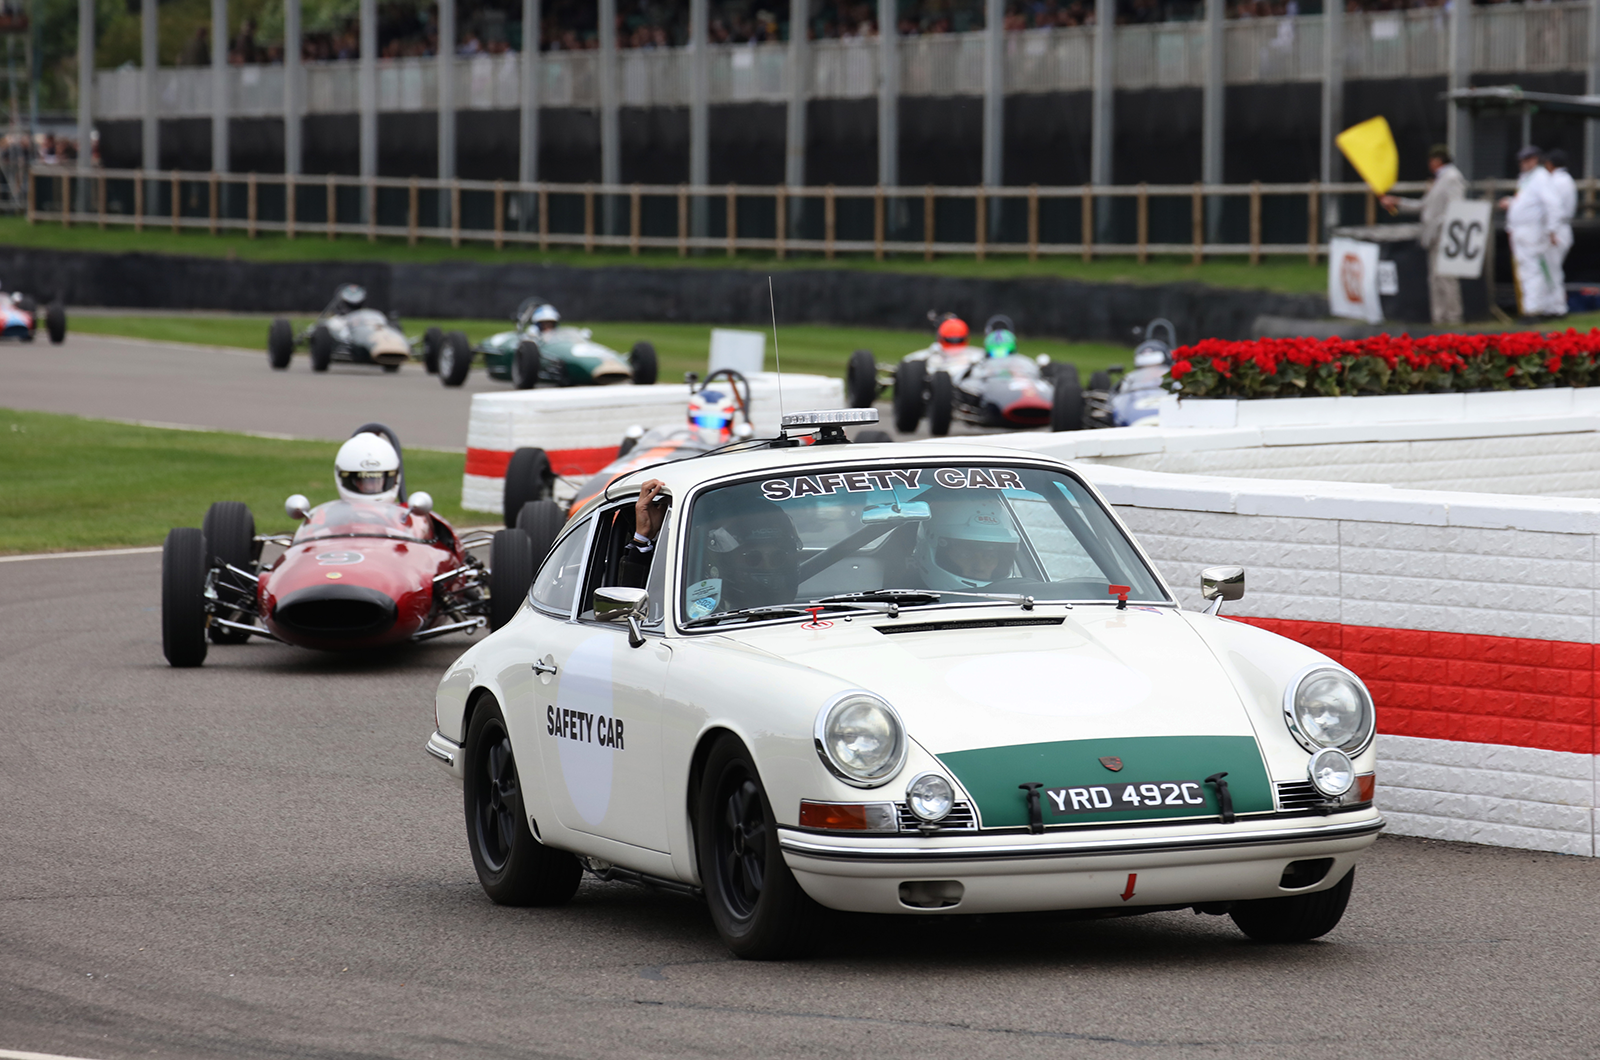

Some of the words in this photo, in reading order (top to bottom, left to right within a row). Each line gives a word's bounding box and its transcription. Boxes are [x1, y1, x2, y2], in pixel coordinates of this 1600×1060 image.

[1445, 220, 1482, 259] SC
[761, 469, 922, 500] SAFETY
[934, 468, 1026, 490] CAR
[547, 704, 593, 743] SAFETY
[597, 715, 624, 750] CAR
[1047, 786, 1113, 811] YRD
[1121, 782, 1204, 807] 492C
